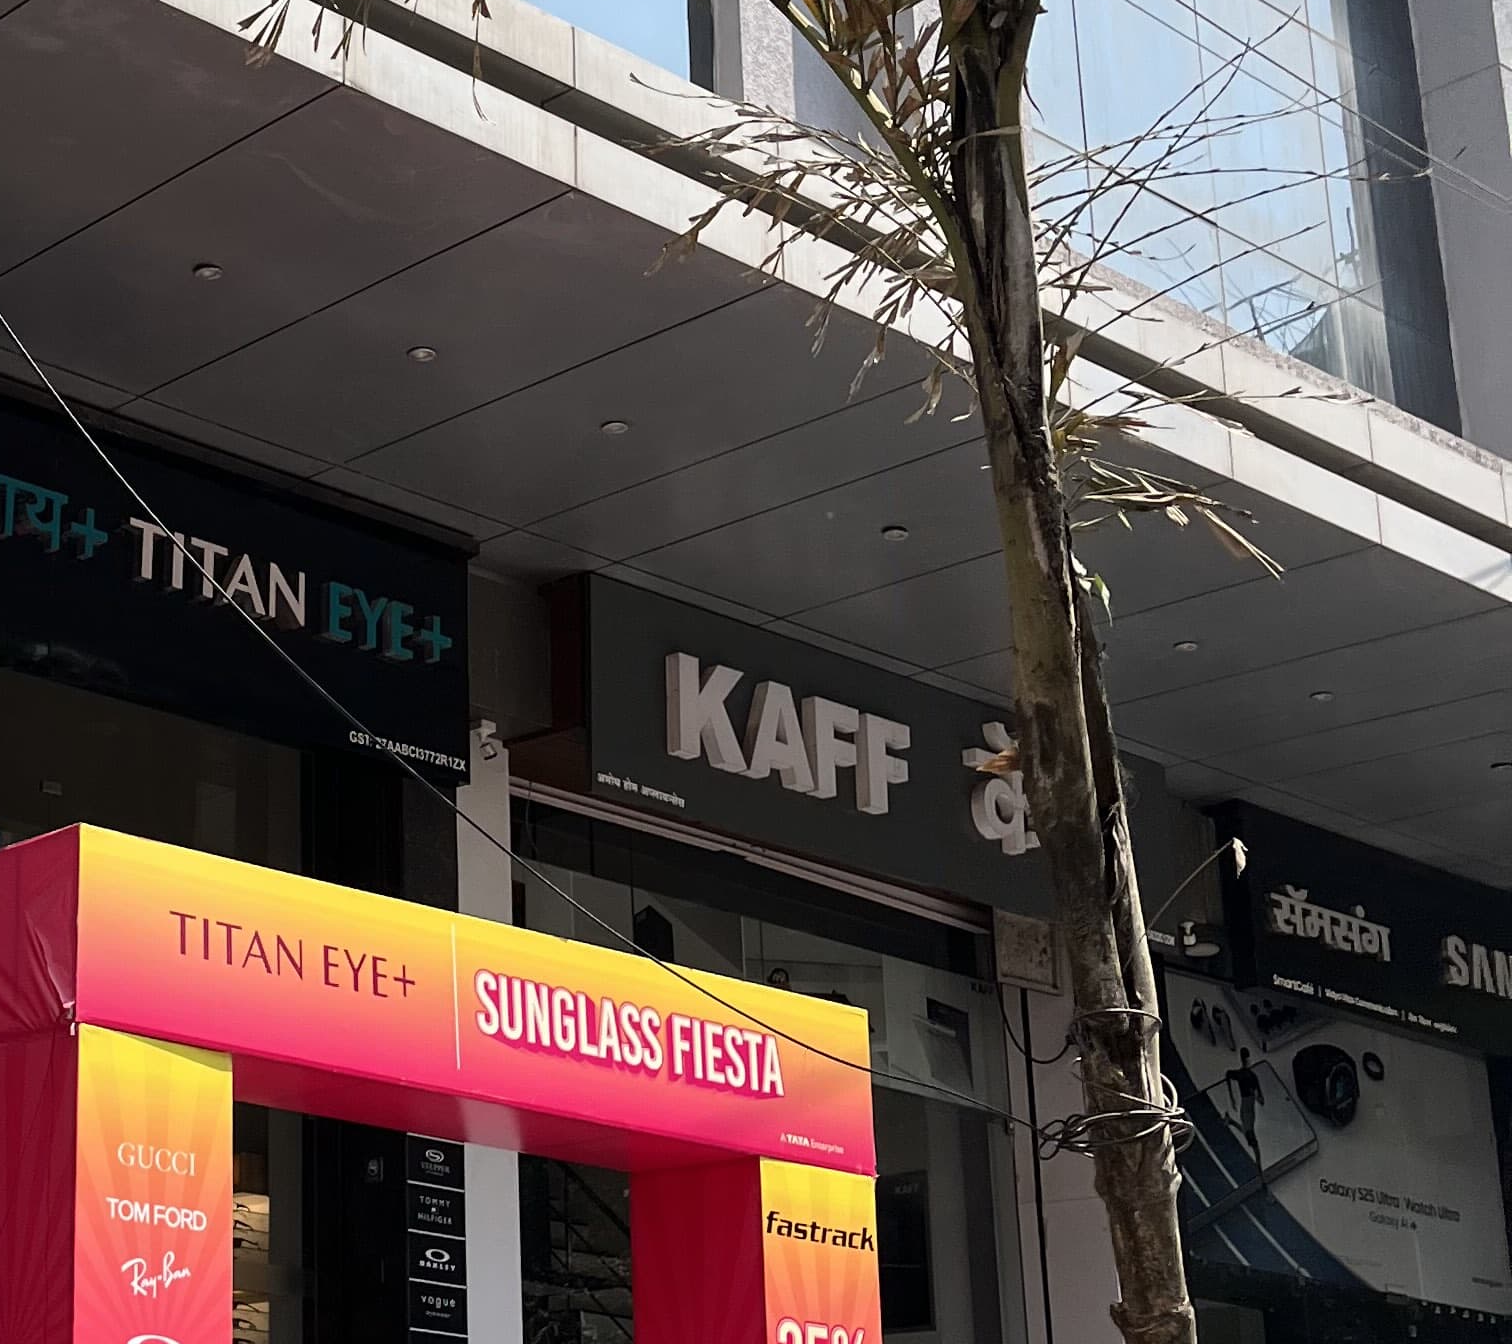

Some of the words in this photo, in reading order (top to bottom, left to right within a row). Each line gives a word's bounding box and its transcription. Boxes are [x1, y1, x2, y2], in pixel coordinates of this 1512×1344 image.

[130, 517, 305, 627] TITAN
[327, 580, 453, 663] EYE+
[665, 652, 911, 814] KAFF
[170, 911, 303, 980] TITAN
[324, 945, 415, 997] EYE+
[475, 969, 664, 1073] SUNGLASS
[670, 1013, 785, 1097] FIESTA
[117, 1142, 196, 1176] GUCCI
[786, 1134, 810, 1147] TATA
[1320, 1179, 1356, 1202] Galaxy
[105, 1196, 150, 1224] TOM
[153, 1205, 207, 1231] FORD
[766, 1210, 875, 1252] fastrack
[120, 1251, 192, 1298] Ray-Ban
[420, 1295, 456, 1309] vogue
